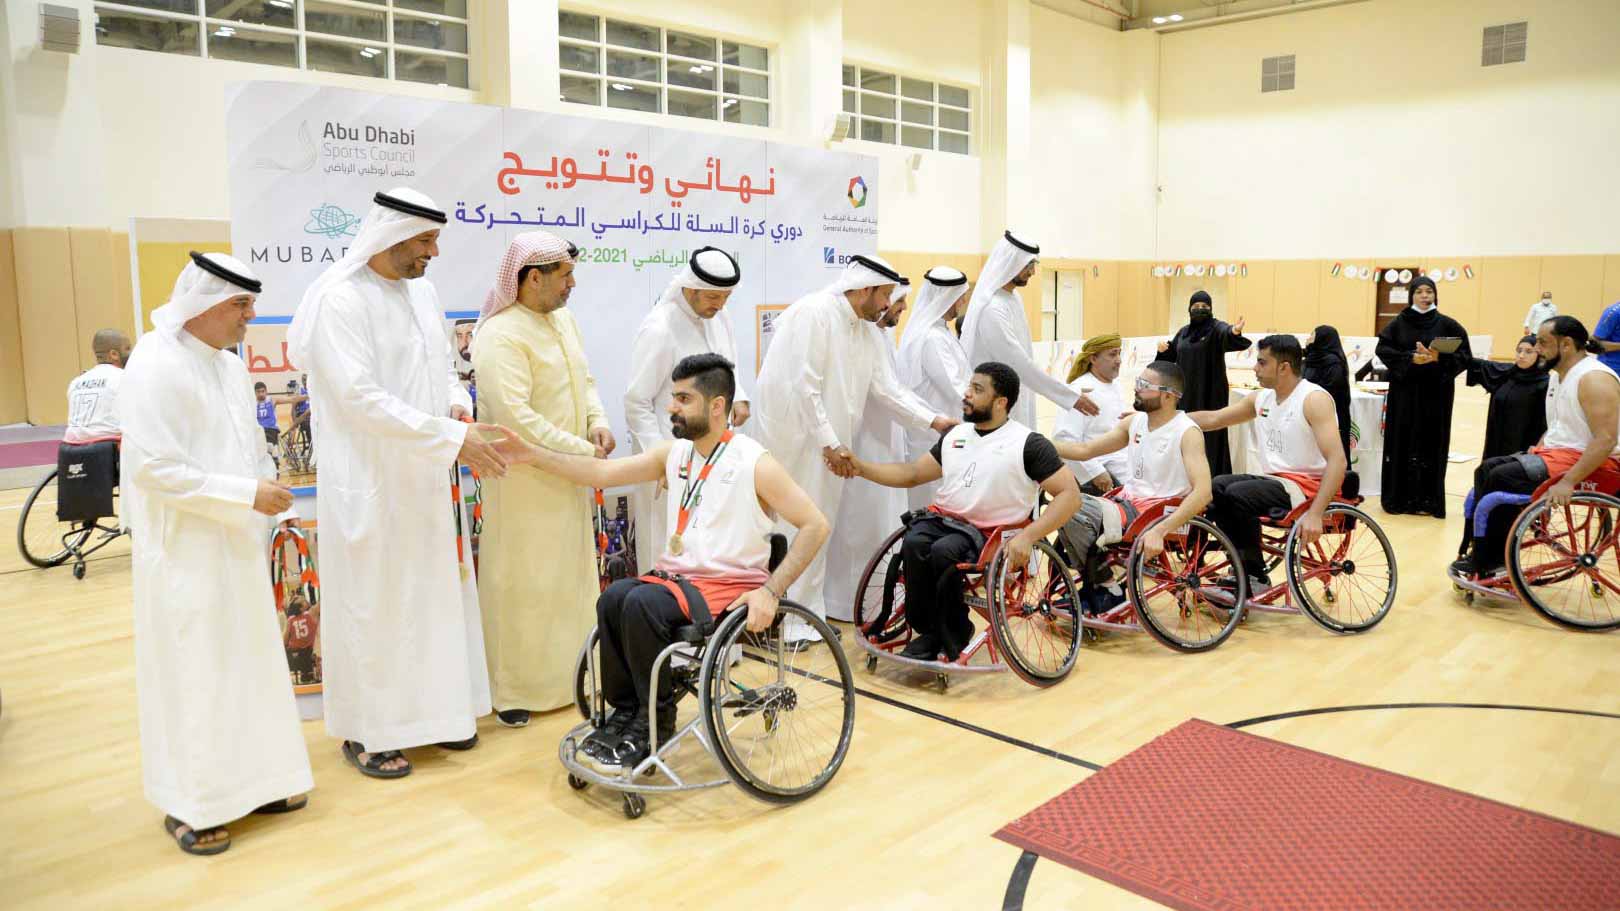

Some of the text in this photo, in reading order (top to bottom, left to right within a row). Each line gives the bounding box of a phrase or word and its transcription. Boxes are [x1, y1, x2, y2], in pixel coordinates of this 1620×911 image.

[323, 121, 415, 146] Abu Dhabi
[323, 142, 415, 162] Sports Council
[323, 162, 356, 174] الرياضي
[390, 167, 415, 177] مجلس
[497, 149, 775, 208] نهائي وتتويج
[455, 201, 803, 244] دوري كرة السلة للكراسي المتحركة
[251, 246, 349, 263] MUBA
[633, 249, 688, 272] الرياضي
[962, 462, 976, 488] 4
[293, 620, 309, 640] 15
